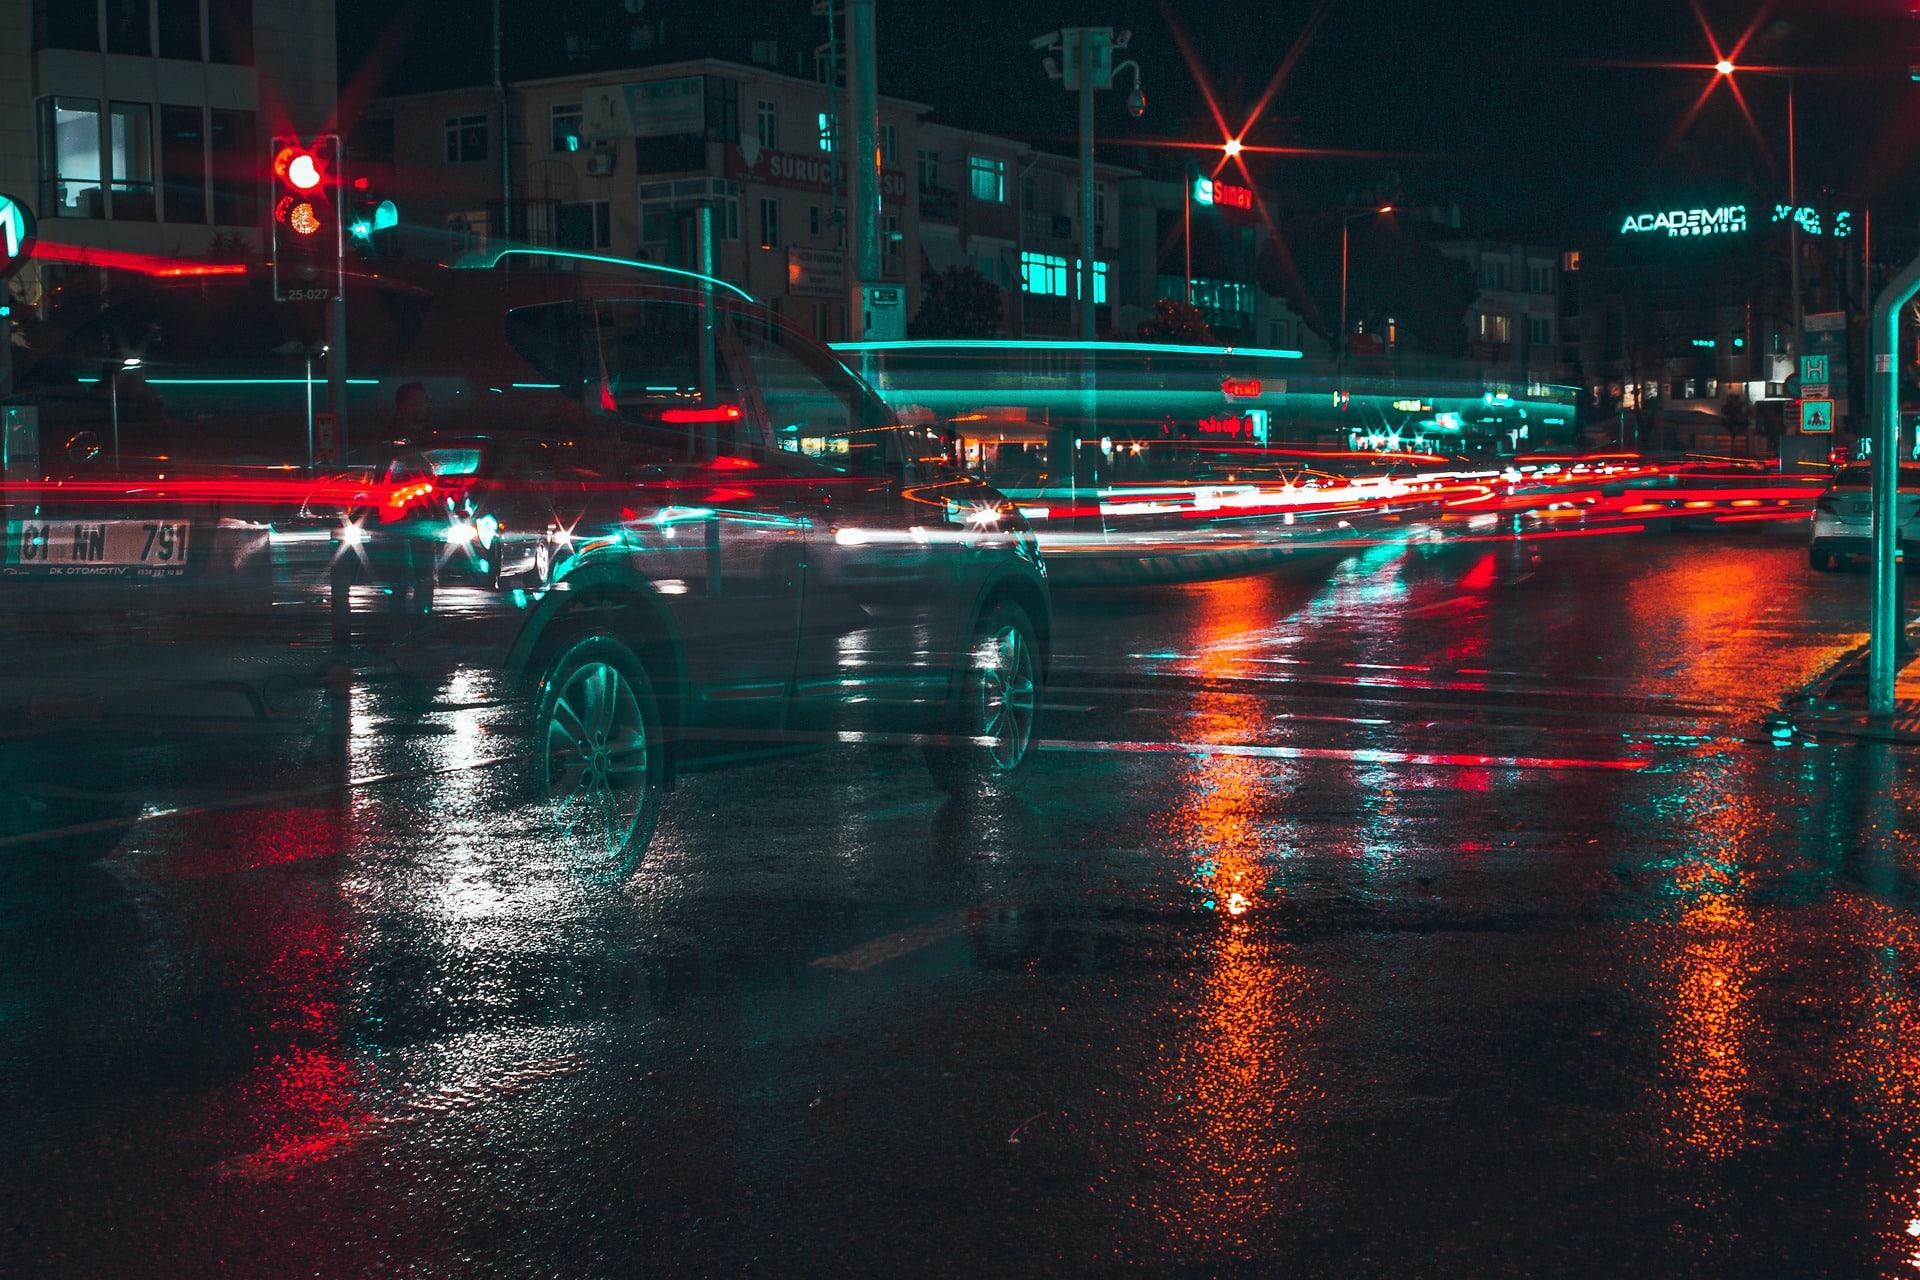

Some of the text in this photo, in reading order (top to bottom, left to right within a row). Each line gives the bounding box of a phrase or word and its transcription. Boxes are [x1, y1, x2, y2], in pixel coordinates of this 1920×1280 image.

[1620, 205, 1746, 234] ACADEMIC
[1668, 221, 1746, 237] hospital
[288, 289, 329, 300] 25-027
[1807, 359, 1823, 379] H
[140, 524, 187, 561] 791
